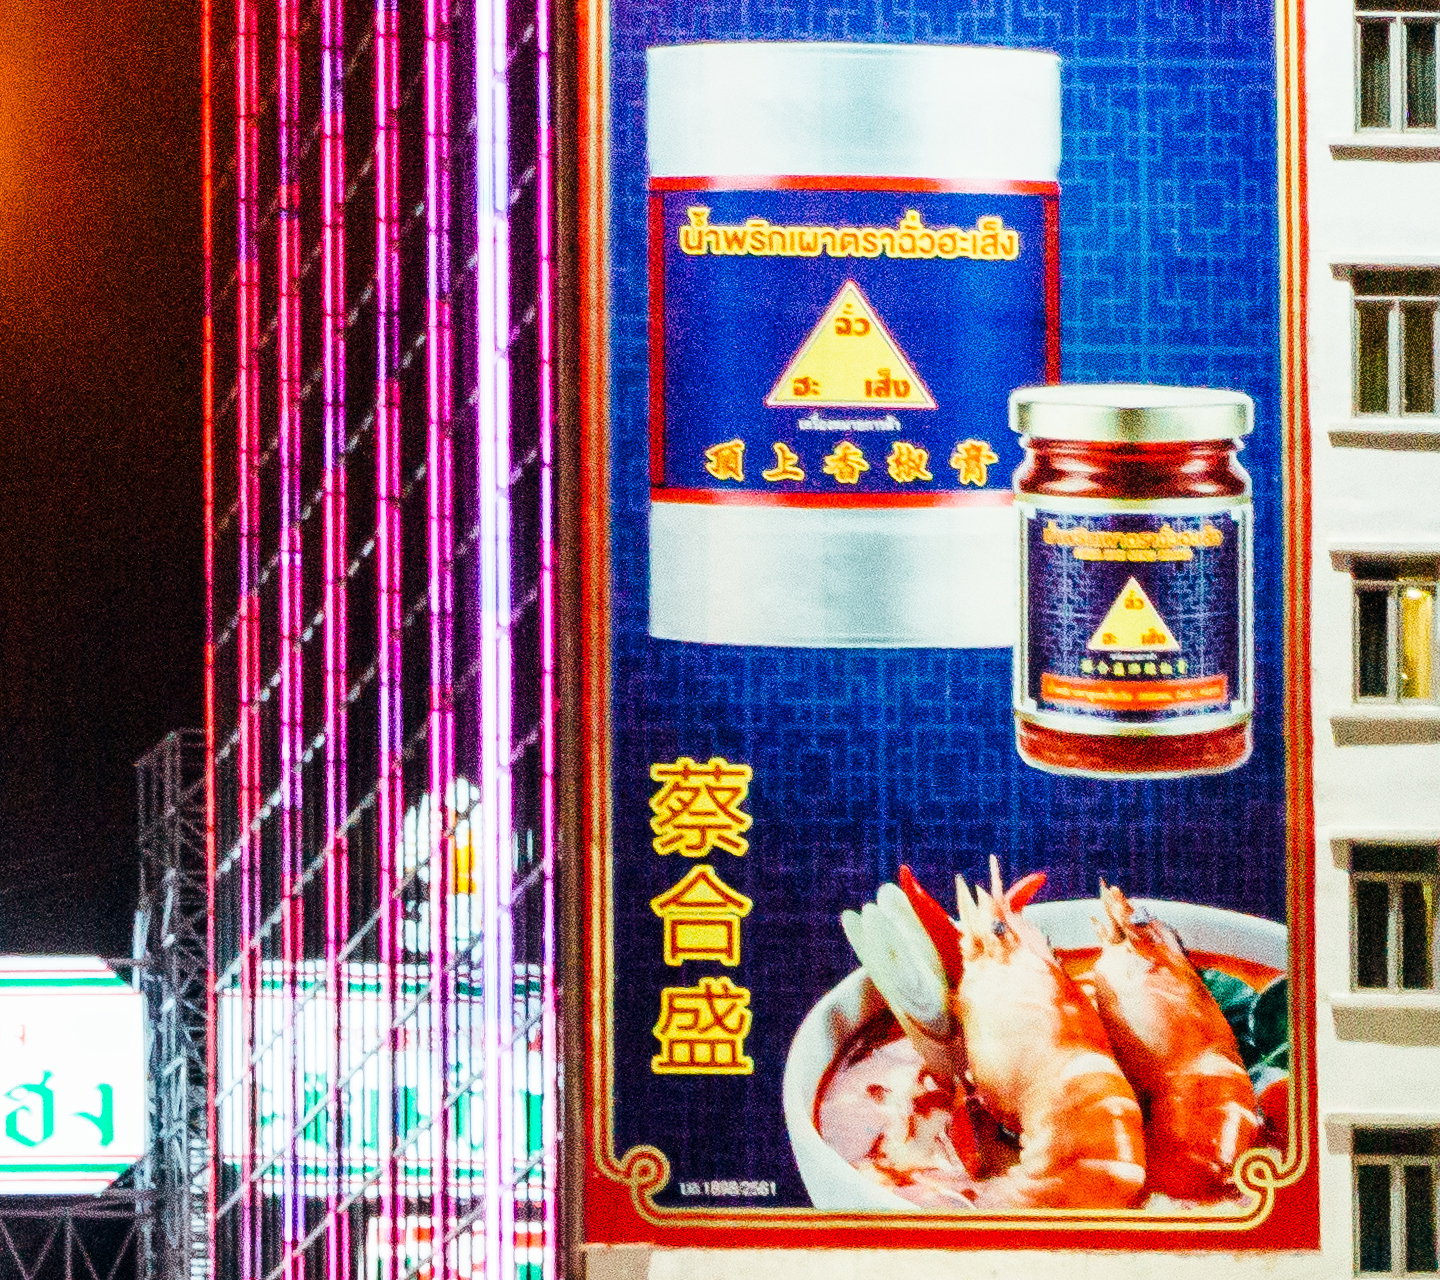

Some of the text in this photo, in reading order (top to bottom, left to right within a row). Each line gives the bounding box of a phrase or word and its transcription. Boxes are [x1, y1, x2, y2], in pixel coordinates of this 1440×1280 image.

[680, 206, 1020, 260] น้ำพริกเผาตราฉั่วฮะเส็ง
[649, 756, 754, 1076] 蔡合盛
